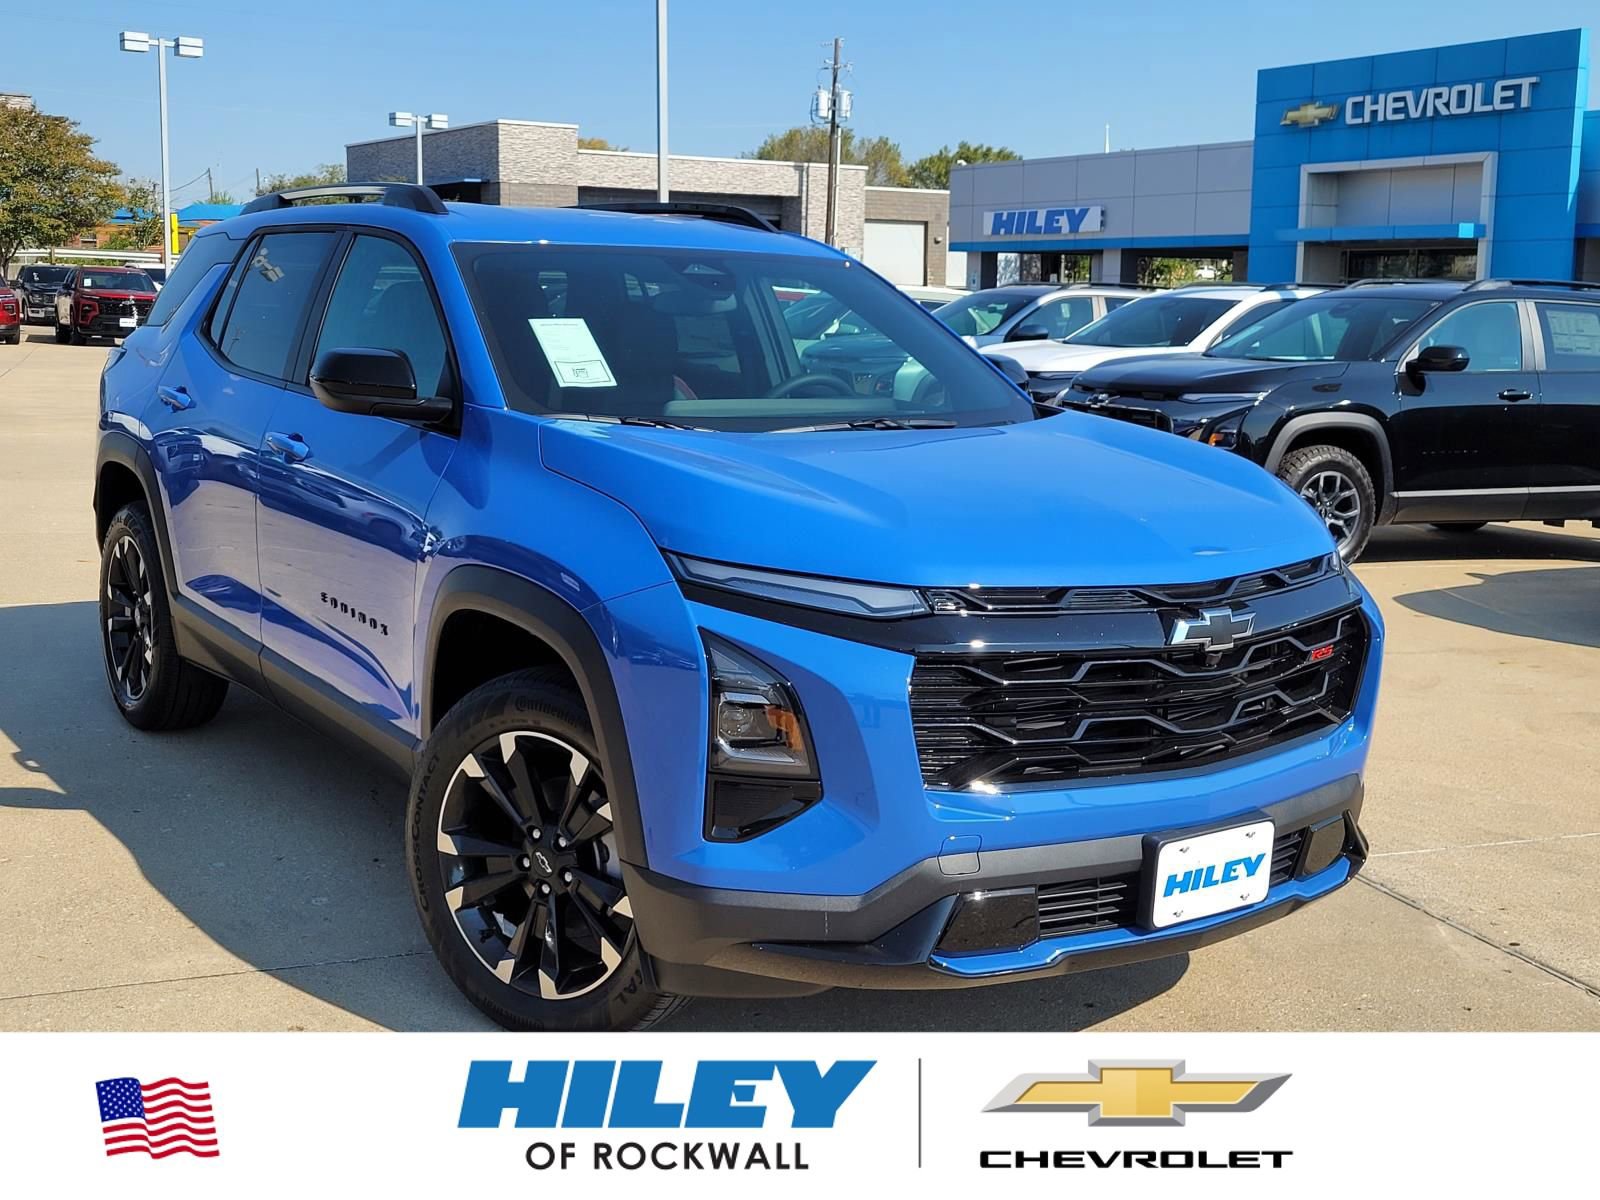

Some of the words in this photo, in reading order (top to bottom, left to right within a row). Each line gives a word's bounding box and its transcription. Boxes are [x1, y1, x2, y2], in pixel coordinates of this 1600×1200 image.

[1345, 76, 1540, 125] CHEVROLET
[991, 207, 1090, 235] HILEY
[320, 592, 388, 635] EQUINOX
[1311, 645, 1335, 661] RS
[1163, 852, 1266, 898] HILEY
